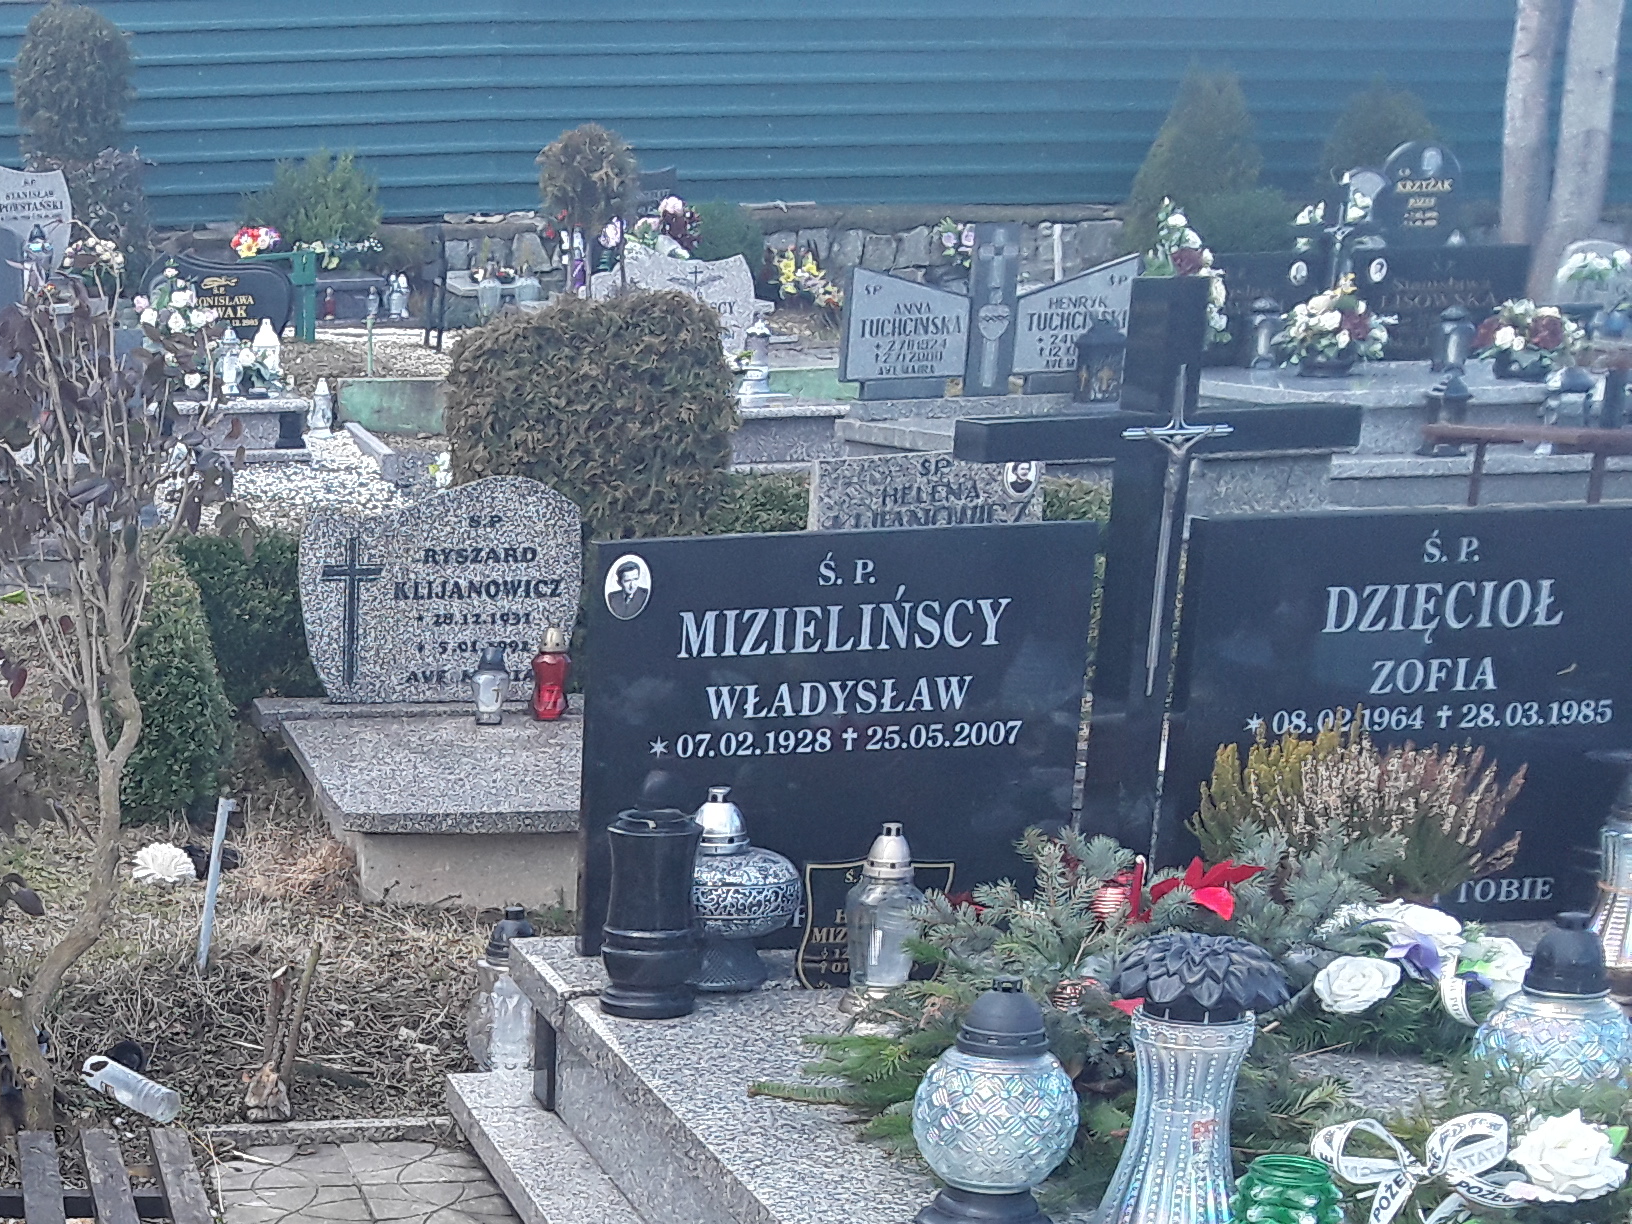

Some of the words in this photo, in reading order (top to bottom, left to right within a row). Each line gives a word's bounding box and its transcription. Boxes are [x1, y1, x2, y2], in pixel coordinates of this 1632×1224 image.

[881, 484, 981, 506] HELENA
[422, 547, 538, 565] RYSZARD
[394, 578, 563, 601] KLIJANOWICZ
[676, 584, 1013, 659] MIZIELIŃSCY
[1320, 577, 1564, 645] DZIĘCIOŁ
[1368, 655, 1498, 695] ZOFIA
[705, 674, 974, 721] WŁADYSŁAW
[1460, 698, 1614, 730] 28.03.1985
[675, 727, 833, 759] 07.02.1928
[865, 719, 1023, 752] 25.05.2007
[1457, 876, 1556, 904] TOBIE
